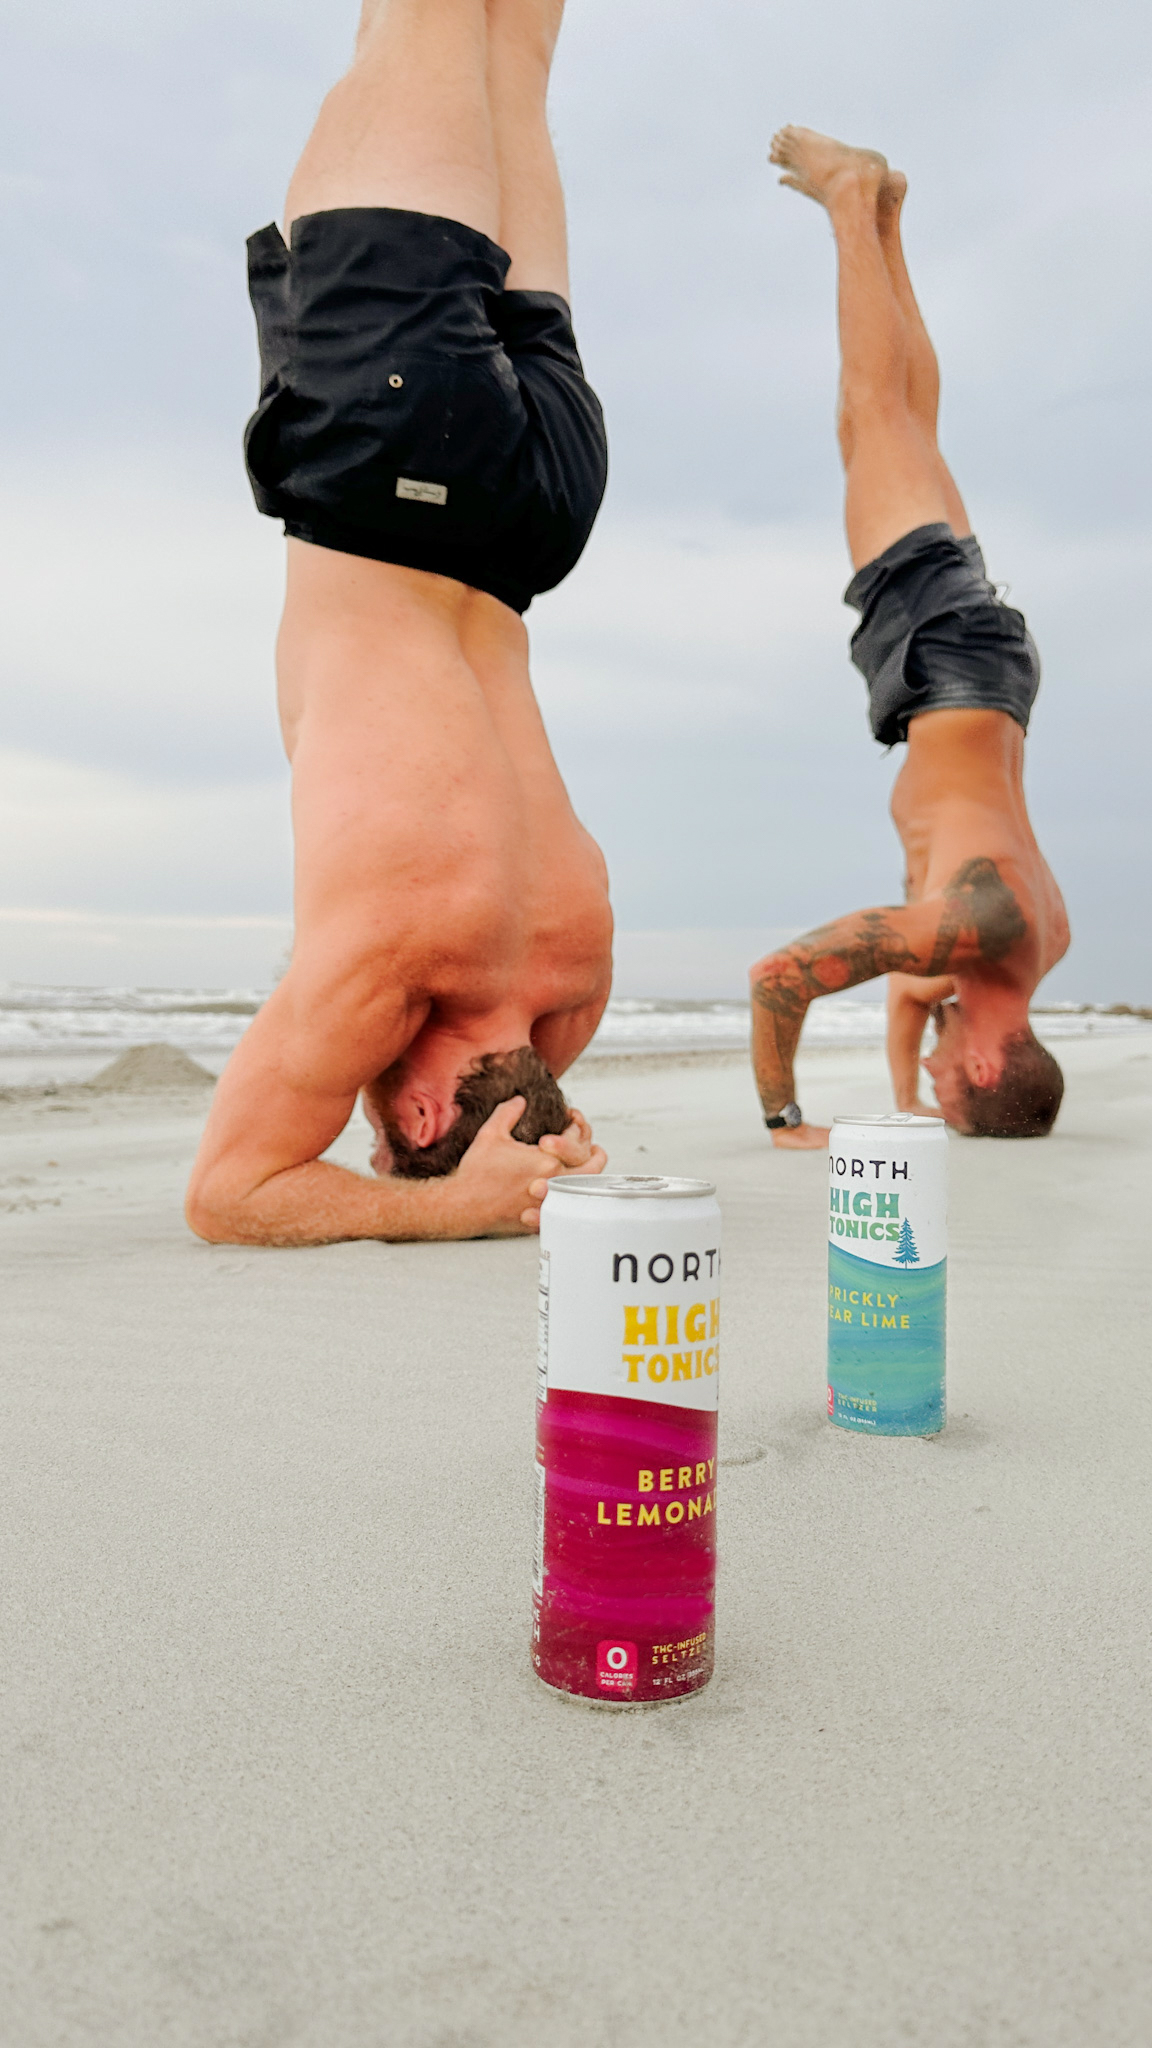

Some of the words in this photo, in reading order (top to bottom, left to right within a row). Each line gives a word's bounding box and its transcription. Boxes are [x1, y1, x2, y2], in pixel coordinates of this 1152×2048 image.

[830, 1187, 900, 1218] HIGH
[830, 1215, 900, 1242] TONICS
[829, 1284, 898, 1308] PRICKLY
[622, 1297, 719, 1346] HIGH
[861, 1312, 910, 1329] LIME
[638, 1457, 715, 1492] BERRY
[652, 1633, 706, 1654] THC-INFUSED
